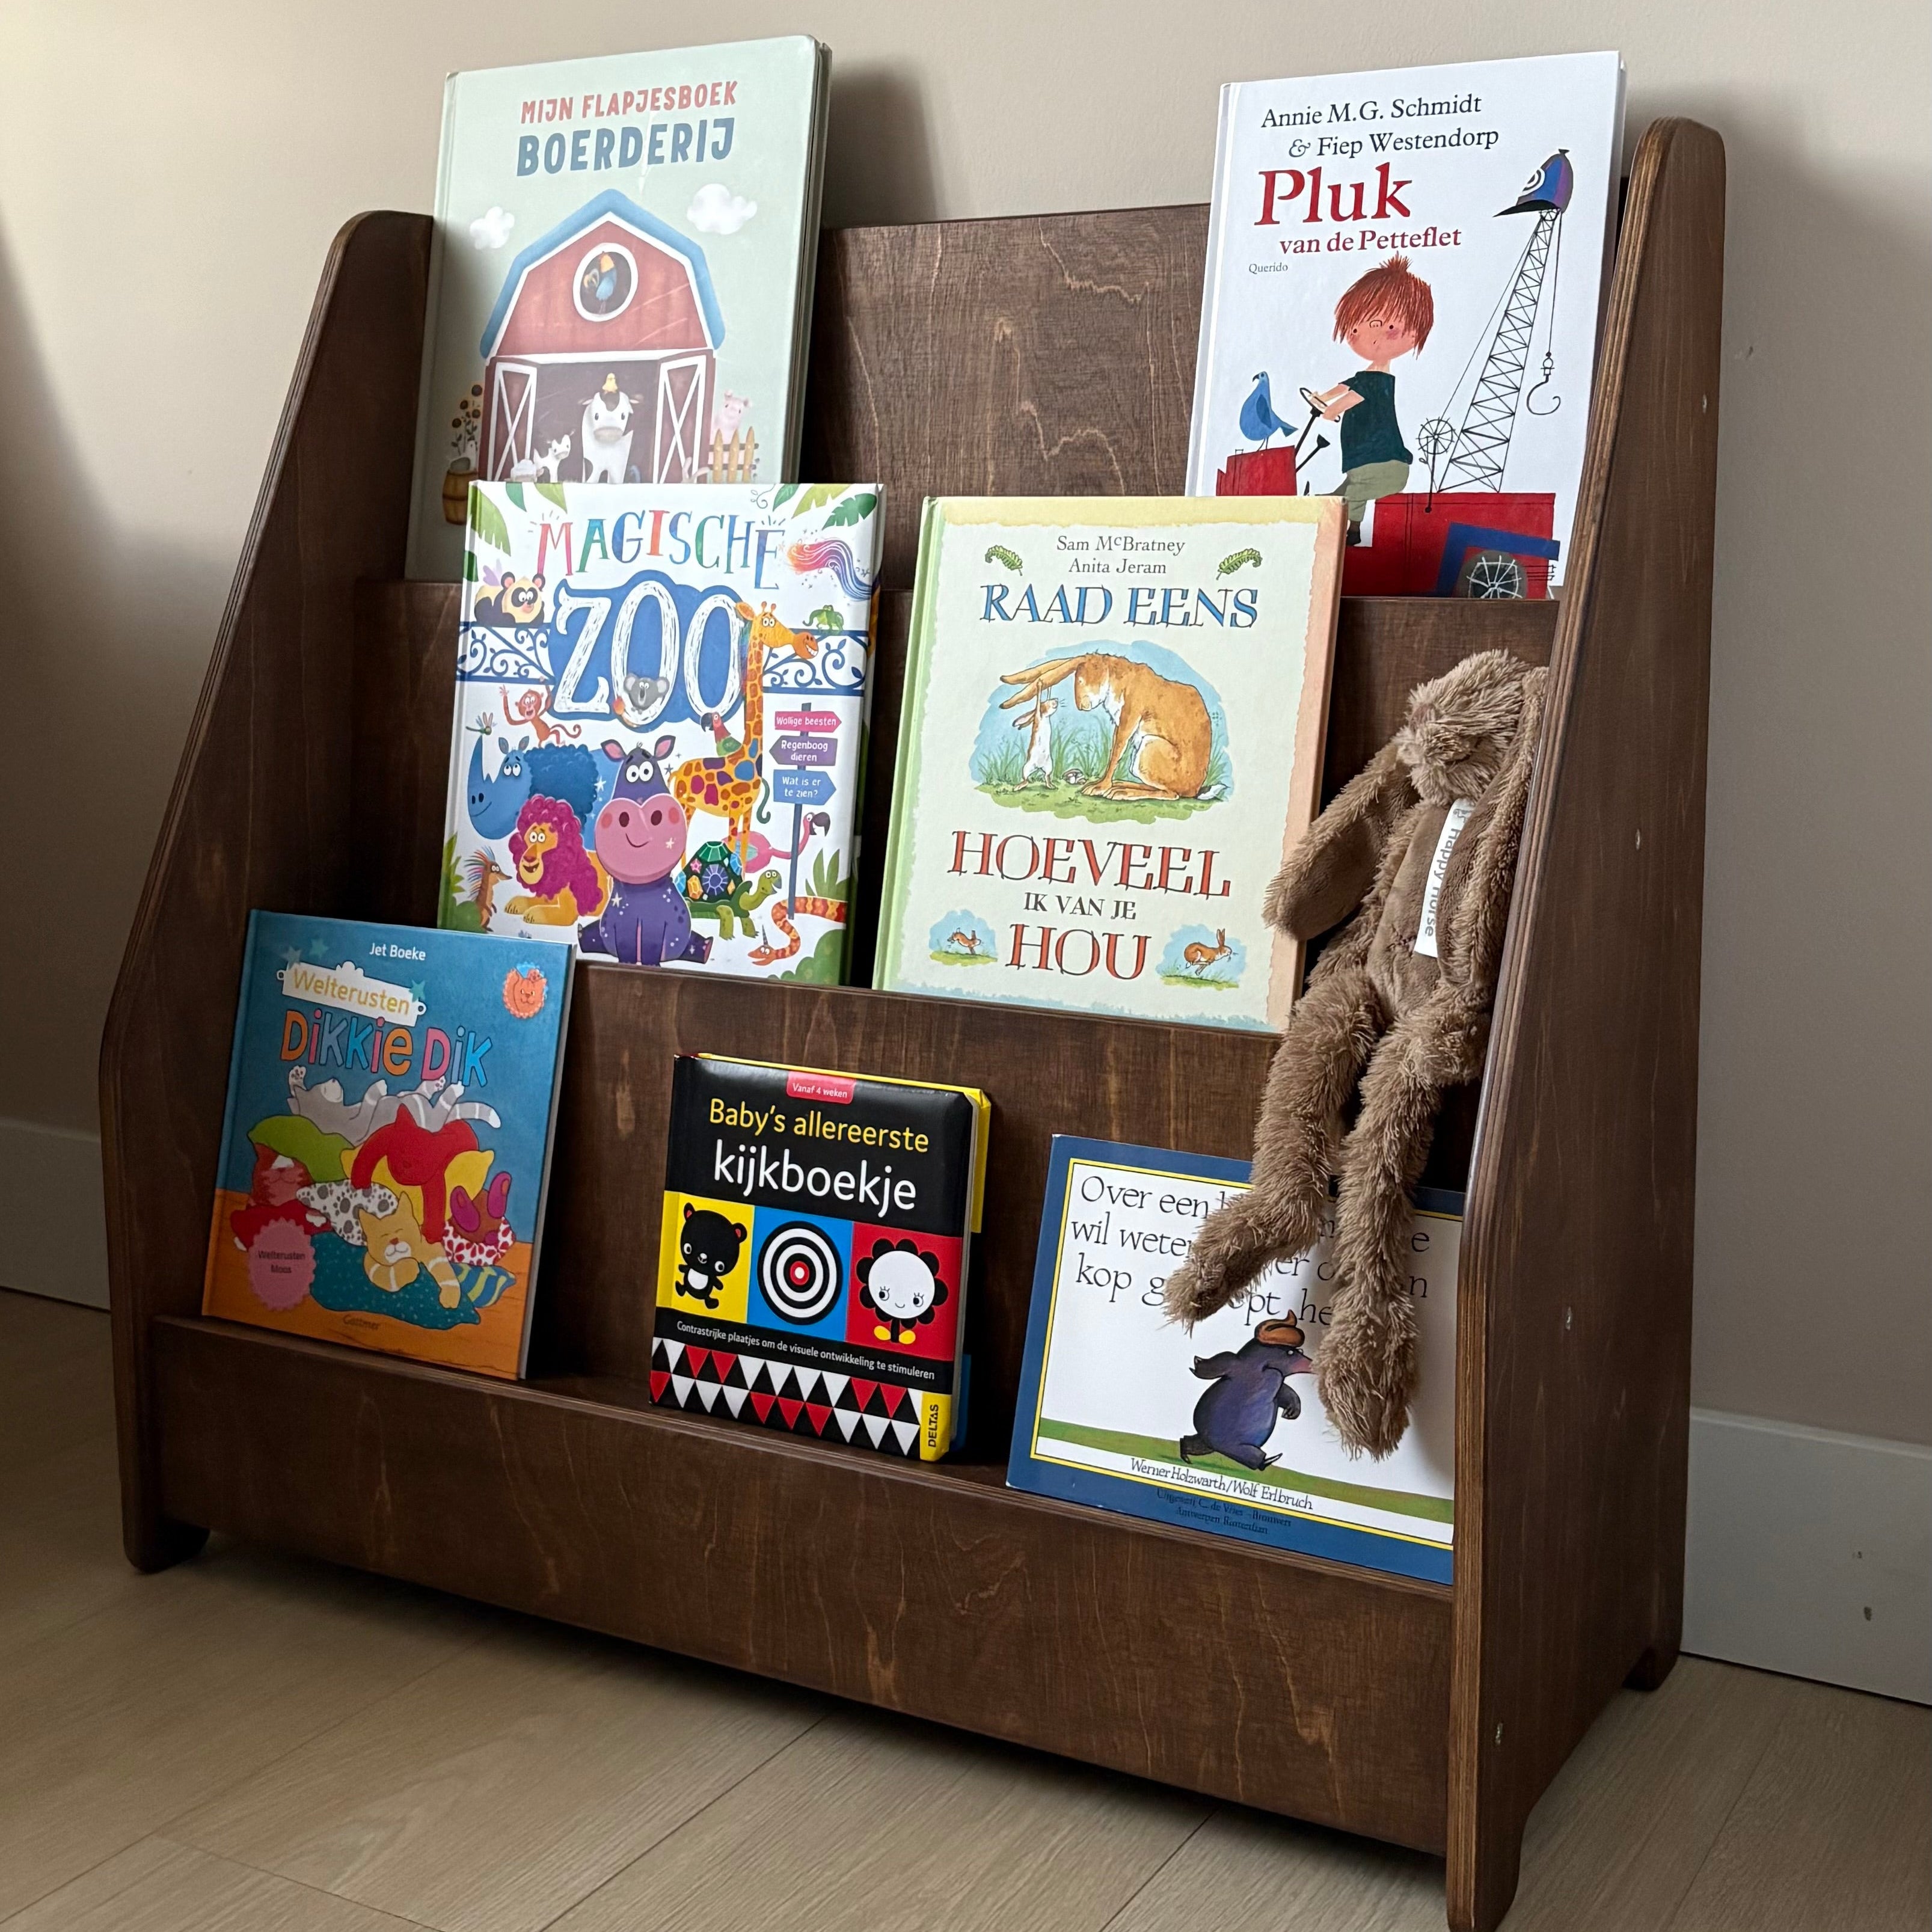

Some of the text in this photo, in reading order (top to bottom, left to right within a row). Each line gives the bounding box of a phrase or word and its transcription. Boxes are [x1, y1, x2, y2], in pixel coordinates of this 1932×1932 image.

[521, 81, 738, 124] MIJN FLAPJESBOEK
[1261, 93, 1482, 128] Annie M.G. Schmidt
[517, 117, 735, 176] BOERDERIJ
[1289, 128, 1499, 158] & Fiep Westendorp
[1254, 162, 1412, 225] Pluk
[1280, 226, 1462, 254] van de Petteflet
[1248, 262, 1289, 275] Querido
[537, 510, 786, 590] MAGISCHE
[1056, 535, 1186, 557] Sam McBratney
[1069, 557, 1167, 574] Anita Jeram
[980, 583, 1259, 630] RAAD EENS
[554, 580, 744, 726] ZOO
[776, 716, 836, 727] Wollige beesten
[781, 740, 828, 752] Regenboog
[790, 753, 817, 762] dieren
[782, 776, 799, 785] Wat
[784, 788, 818, 798] te zien?
[947, 830, 1231, 900] HOEVEEL
[1434, 828, 1461, 881] Happy
[1023, 891, 1136, 920] IK VAN JE
[369, 942, 426, 961] Jet Boeke
[1005, 924, 1152, 980] HOU
[293, 969, 411, 1015] Welterusten
[792, 1082, 815, 1094] Vanaf
[823, 1087, 848, 1099] weken
[709, 1097, 929, 1153] Baby's allereerste
[714, 1139, 916, 1218] kijkboekje
[1081, 1176, 1153, 1209] Over
[1159, 1194, 1209, 1219] een
[1071, 1211, 1111, 1245] wil
[1076, 1252, 1132, 1303] kop
[676, 1320, 934, 1380] Contrastrijke plaatjes om de visuele ontwikkeling te stimuleren
[928, 1404, 939, 1448] DELTAS
[1130, 1458, 1171, 1478] Werner
[1260, 1485, 1314, 1510] Erlbruch
